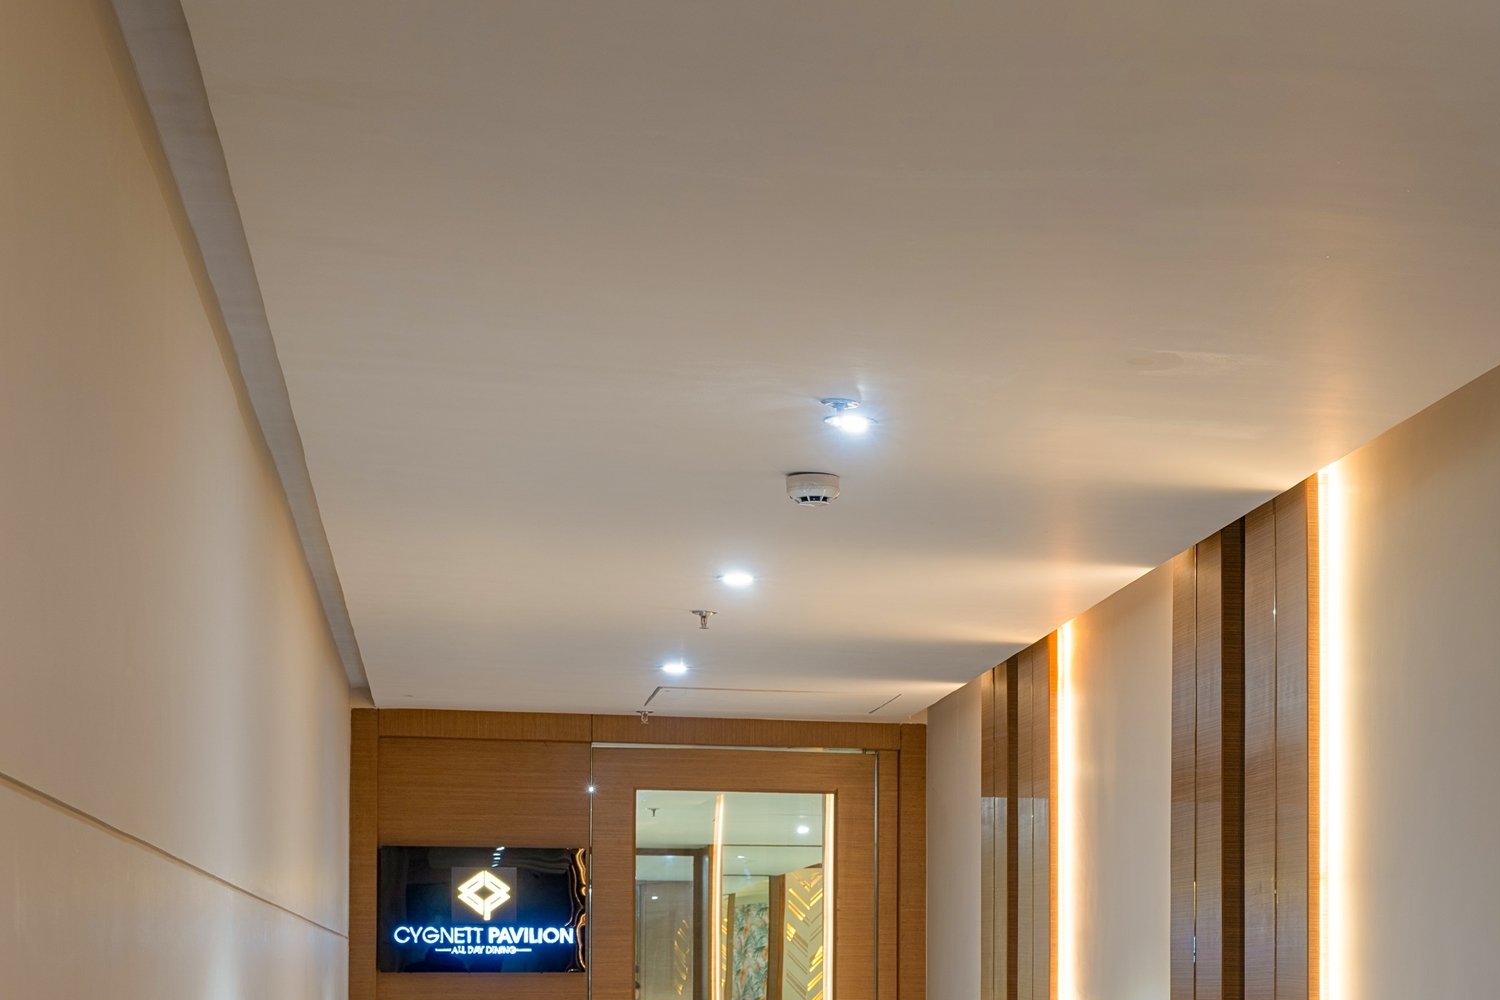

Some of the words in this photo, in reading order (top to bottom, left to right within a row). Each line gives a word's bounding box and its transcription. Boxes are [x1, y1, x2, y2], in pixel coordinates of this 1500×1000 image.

[394, 926, 484, 944] CYGNETT
[488, 926, 574, 944] PAVILION
[451, 945, 466, 955] ALL
[467, 945, 485, 955] DAY
[485, 945, 517, 955] DINING
